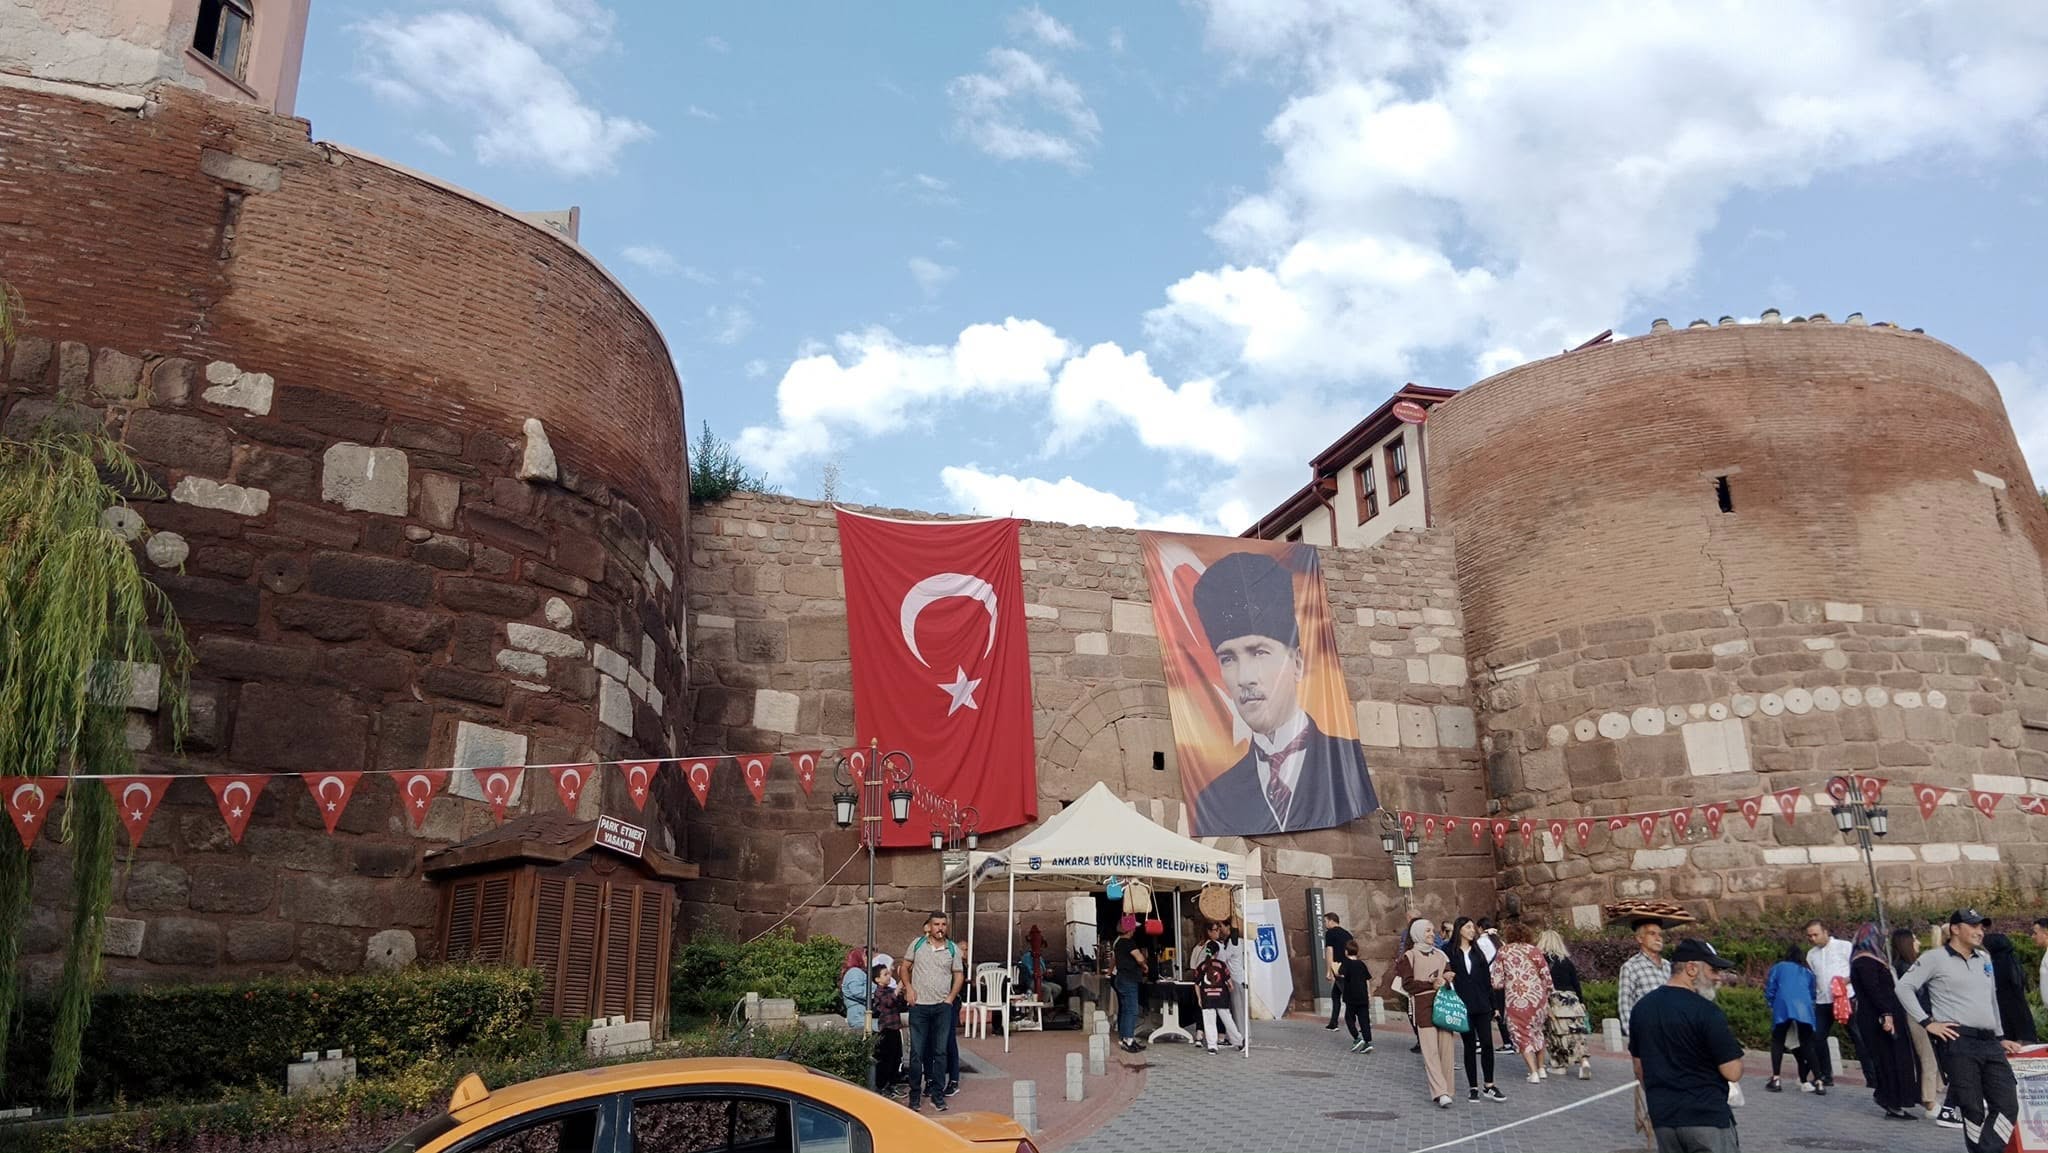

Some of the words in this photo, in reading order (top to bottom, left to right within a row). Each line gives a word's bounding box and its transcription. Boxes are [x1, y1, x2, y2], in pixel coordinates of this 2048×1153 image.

[601, 818, 619, 833] PARK
[620, 826, 644, 842] ETMEK
[604, 832, 636, 852] YASAKTIR
[1052, 856, 1090, 866] ANKARA
[1094, 852, 1153, 869] BÜYÜKŞEHİR
[1156, 858, 1209, 874] BELEDİYESİ
